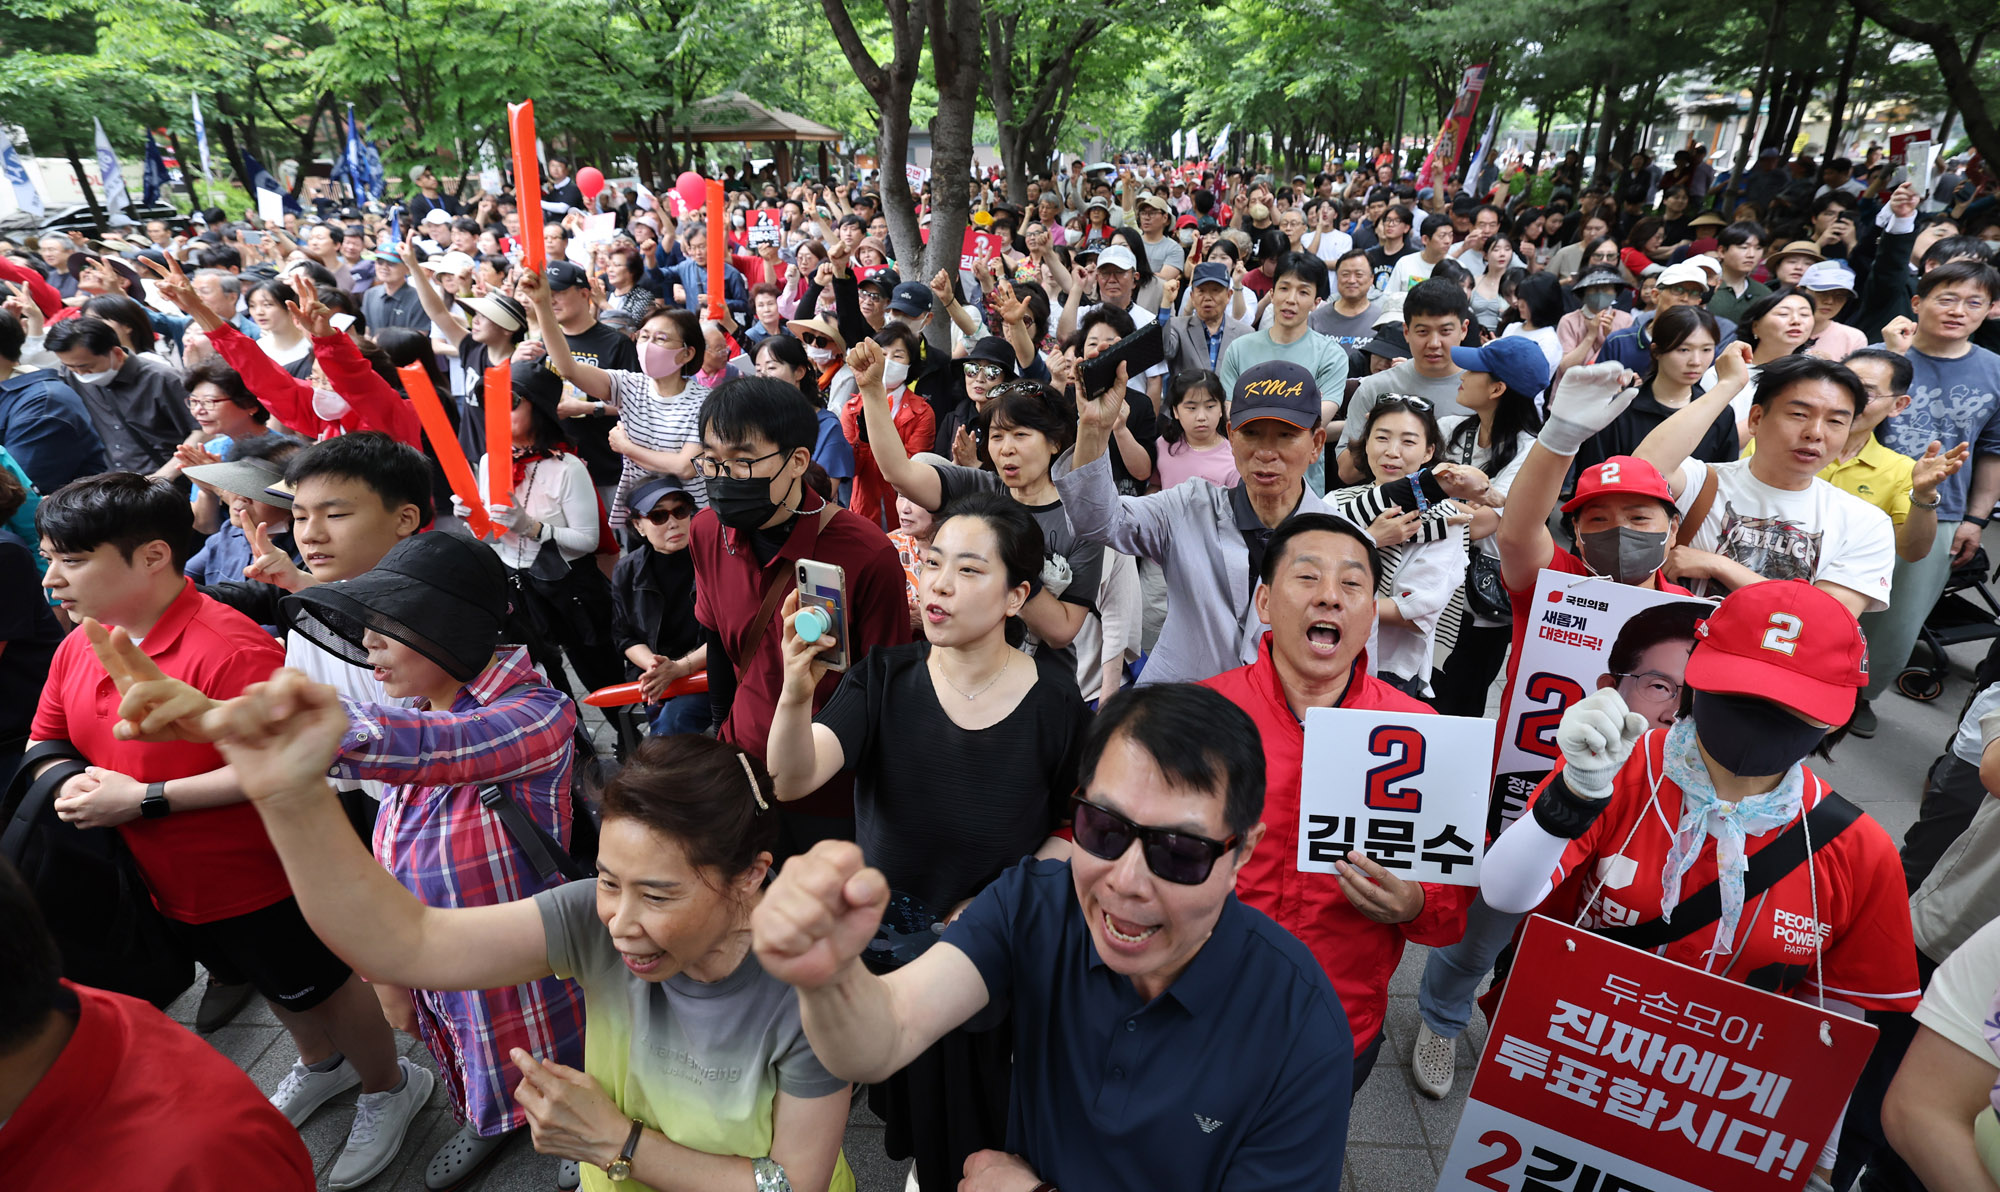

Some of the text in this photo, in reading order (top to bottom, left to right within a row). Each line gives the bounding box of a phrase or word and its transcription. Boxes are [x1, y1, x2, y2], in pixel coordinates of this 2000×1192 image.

[974, 235, 990, 255] 2
[1244, 379, 1304, 399] KMA
[1601, 462, 1621, 486] 2
[1716, 520, 1817, 569] METALLICA
[1541, 610, 1588, 631] 새롭게
[1566, 595, 1609, 612] 국민의힘
[1538, 625, 1604, 651] 대한민국!
[1760, 611, 1804, 657] 2
[1514, 672, 1586, 761] 2
[1364, 724, 1427, 813] 2
[1308, 814, 1475, 875] 김문수
[1773, 908, 1832, 937] PEOPLE
[1783, 943, 1812, 956] PARTY
[1601, 973, 1764, 1051] 두손모아
[1546, 999, 1793, 1119] 진짜에게
[1494, 1034, 1809, 1181] 투표합시다!
